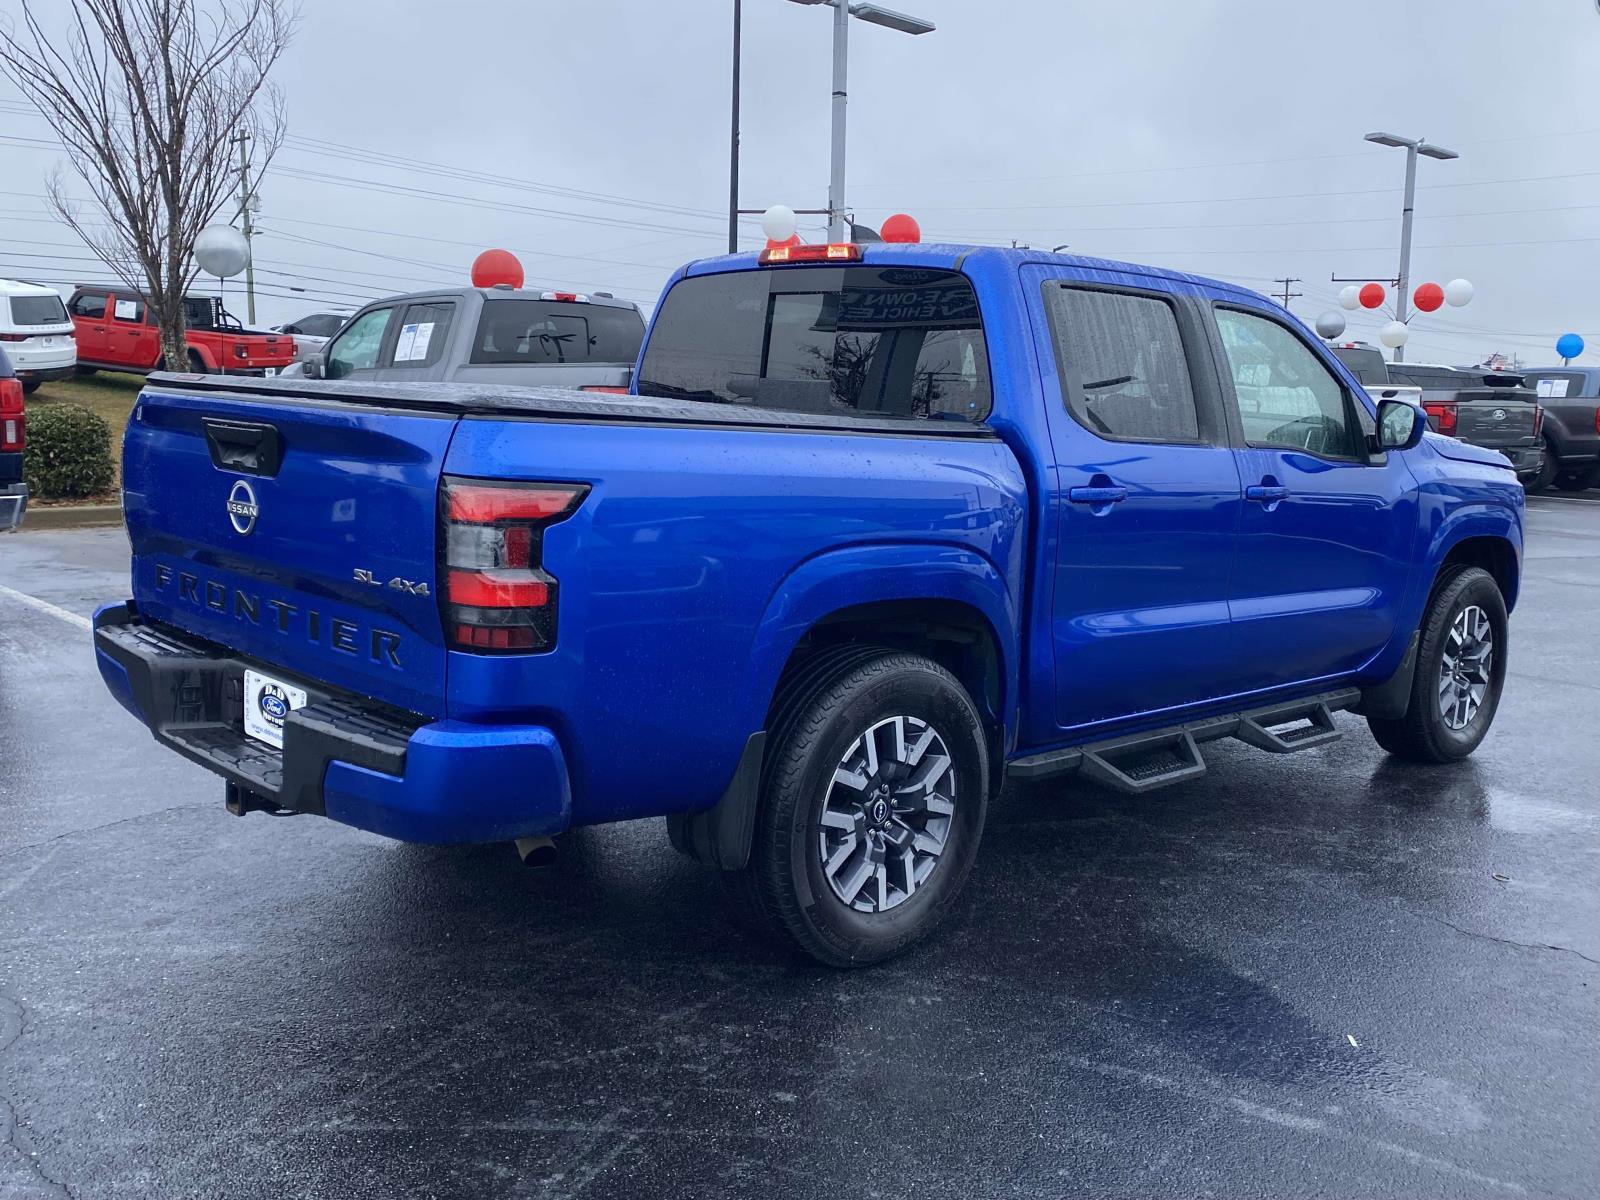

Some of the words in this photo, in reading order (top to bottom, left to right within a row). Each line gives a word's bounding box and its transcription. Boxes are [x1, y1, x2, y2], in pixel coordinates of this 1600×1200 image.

[353, 568, 383, 585] SL
[155, 563, 402, 671] FRONTIER
[266, 698, 282, 715] Ford
